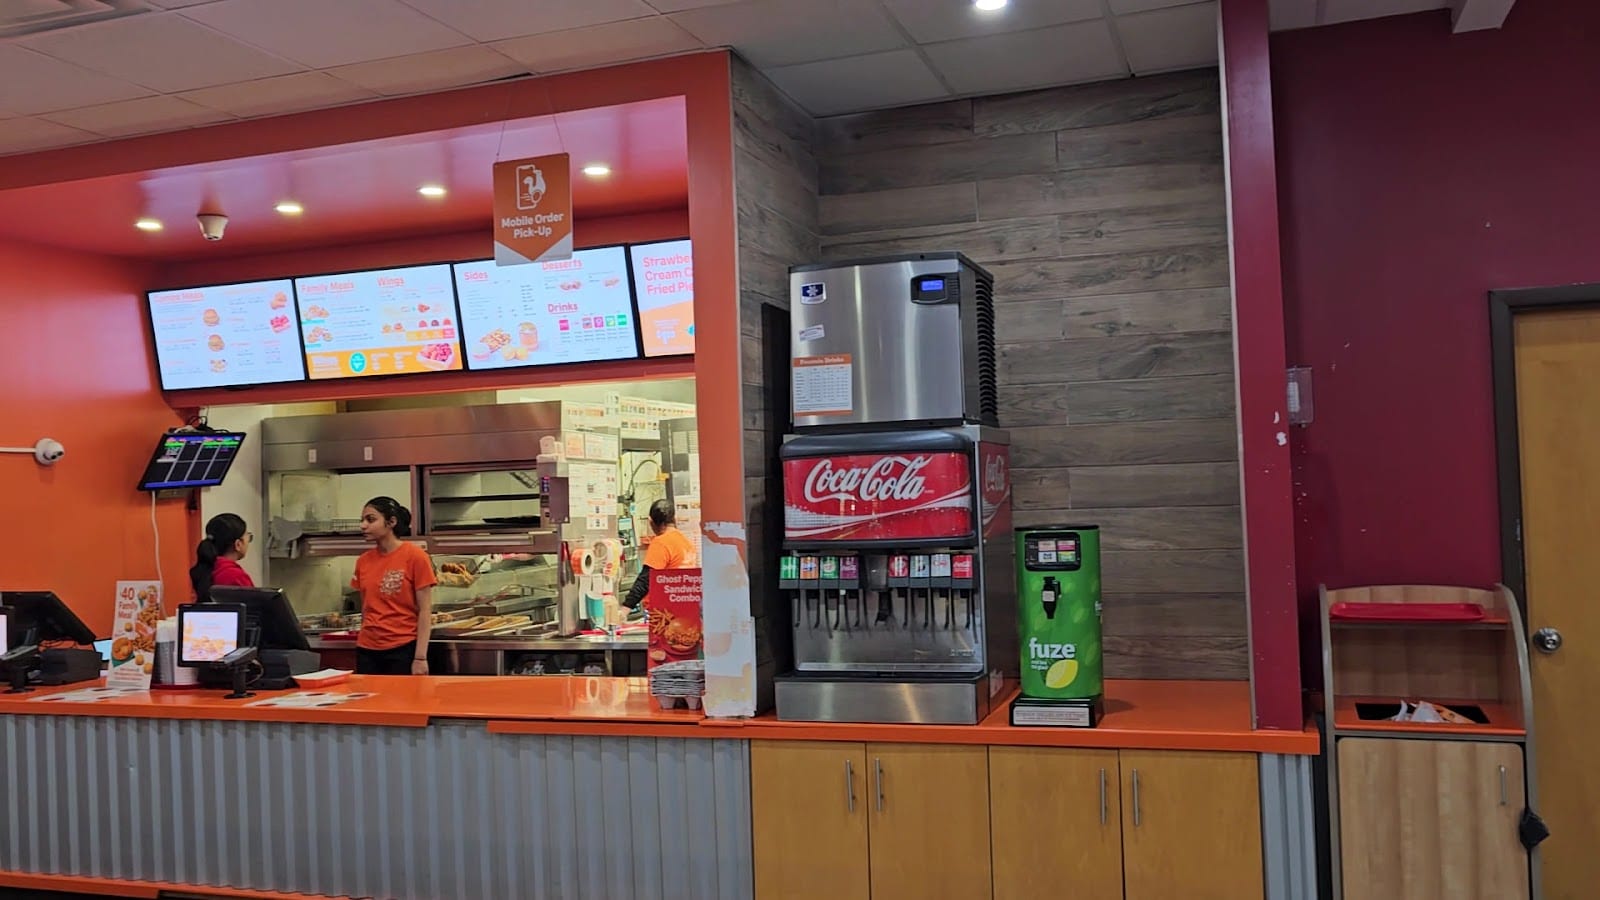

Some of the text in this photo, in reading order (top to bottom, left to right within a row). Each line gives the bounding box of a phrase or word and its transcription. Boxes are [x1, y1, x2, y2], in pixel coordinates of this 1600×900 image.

[501, 212, 564, 228] Mobile Order
[513, 225, 552, 239] Pick-Up
[542, 259, 583, 270] Desserts
[464, 271, 488, 280] Sides
[645, 270, 681, 282] Cream
[301, 280, 354, 293] Family Meals
[377, 277, 404, 287] Wings
[647, 282, 675, 295] Fried
[547, 302, 578, 313] Drinks
[804, 455, 933, 503] Coca-Cola
[656, 574, 682, 584] Ghost
[669, 594, 701, 602] Combo
[1029, 637, 1076, 659] fuze
